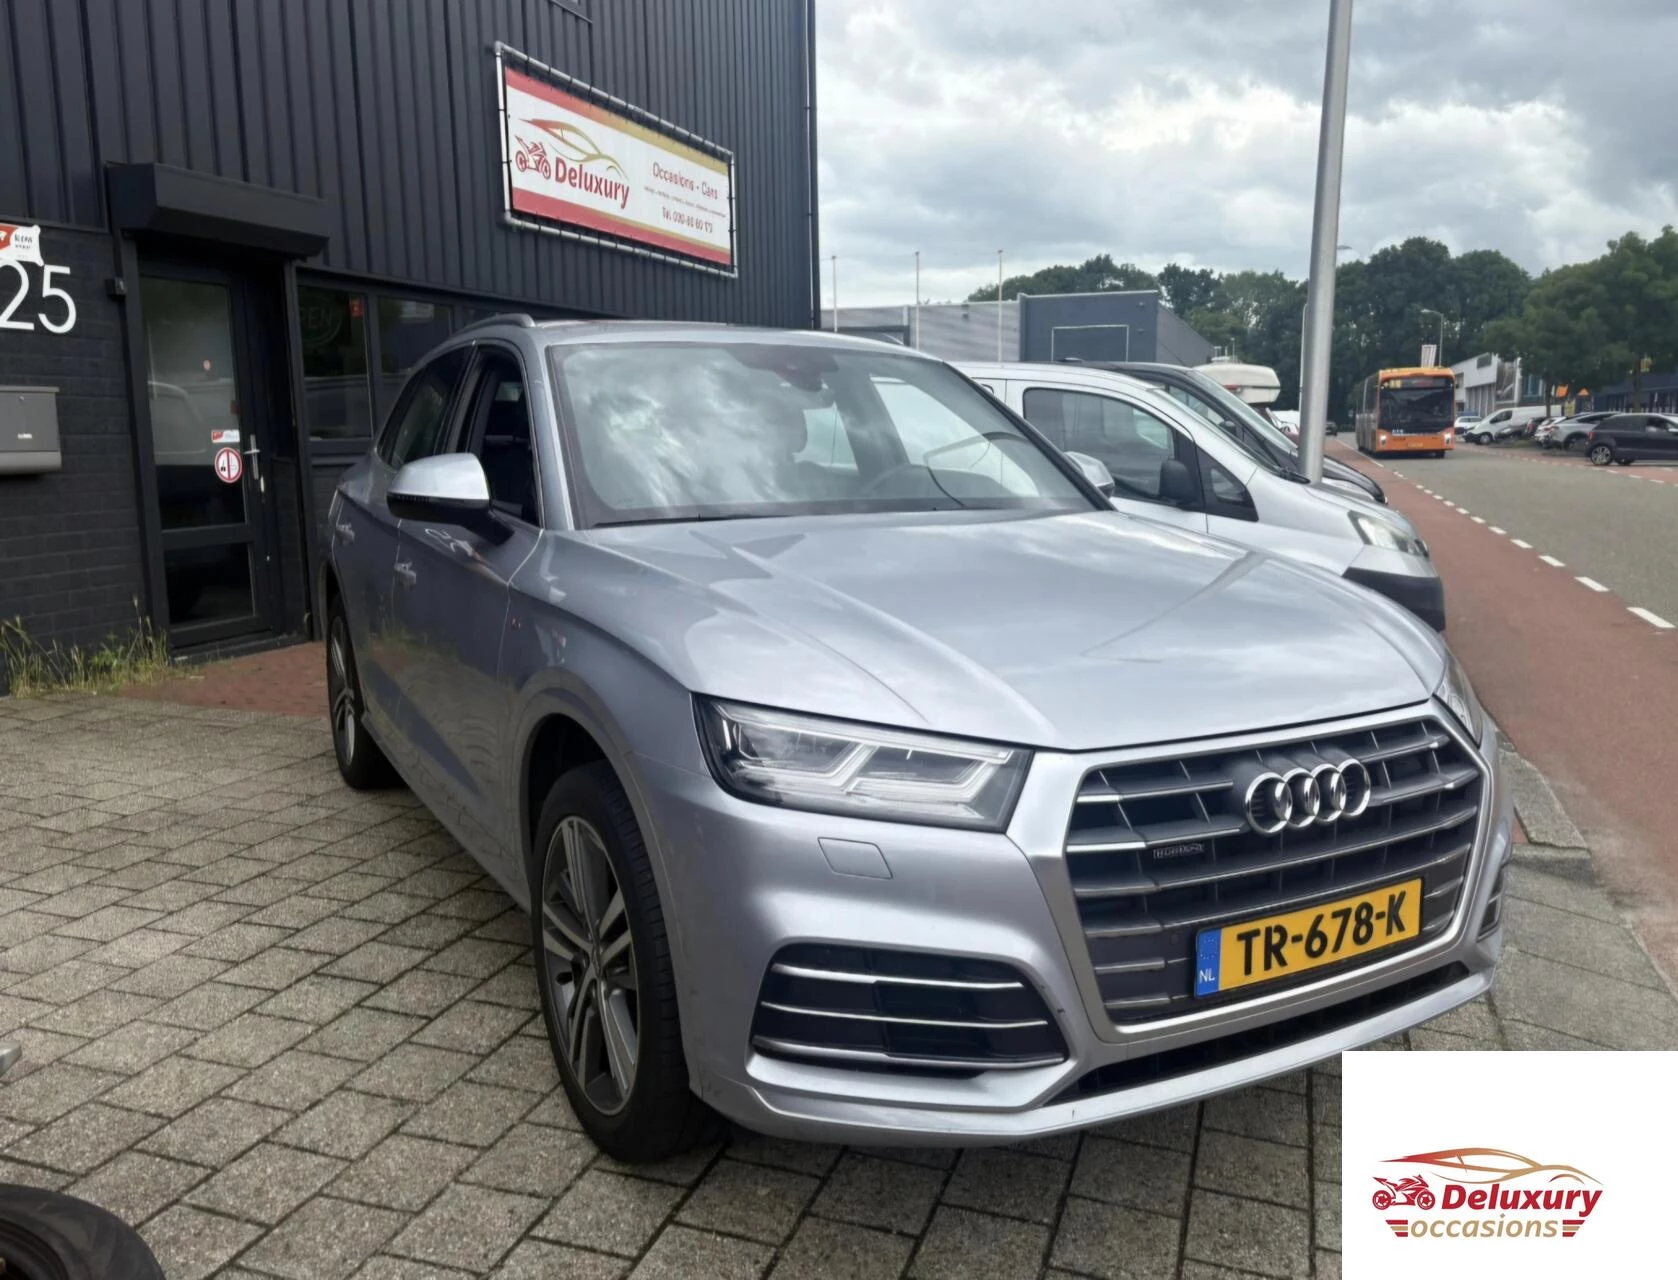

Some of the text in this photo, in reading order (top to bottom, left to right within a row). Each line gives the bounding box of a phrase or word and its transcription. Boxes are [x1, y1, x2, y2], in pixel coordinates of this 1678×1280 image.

[554, 156, 631, 210] Deluxury
[652, 161, 694, 191] Occasions
[701, 181, 718, 201] Cars
[0, 259, 77, 334] 25
[1236, 890, 1407, 976] TR-678-K
[1199, 967, 1215, 983] NL
